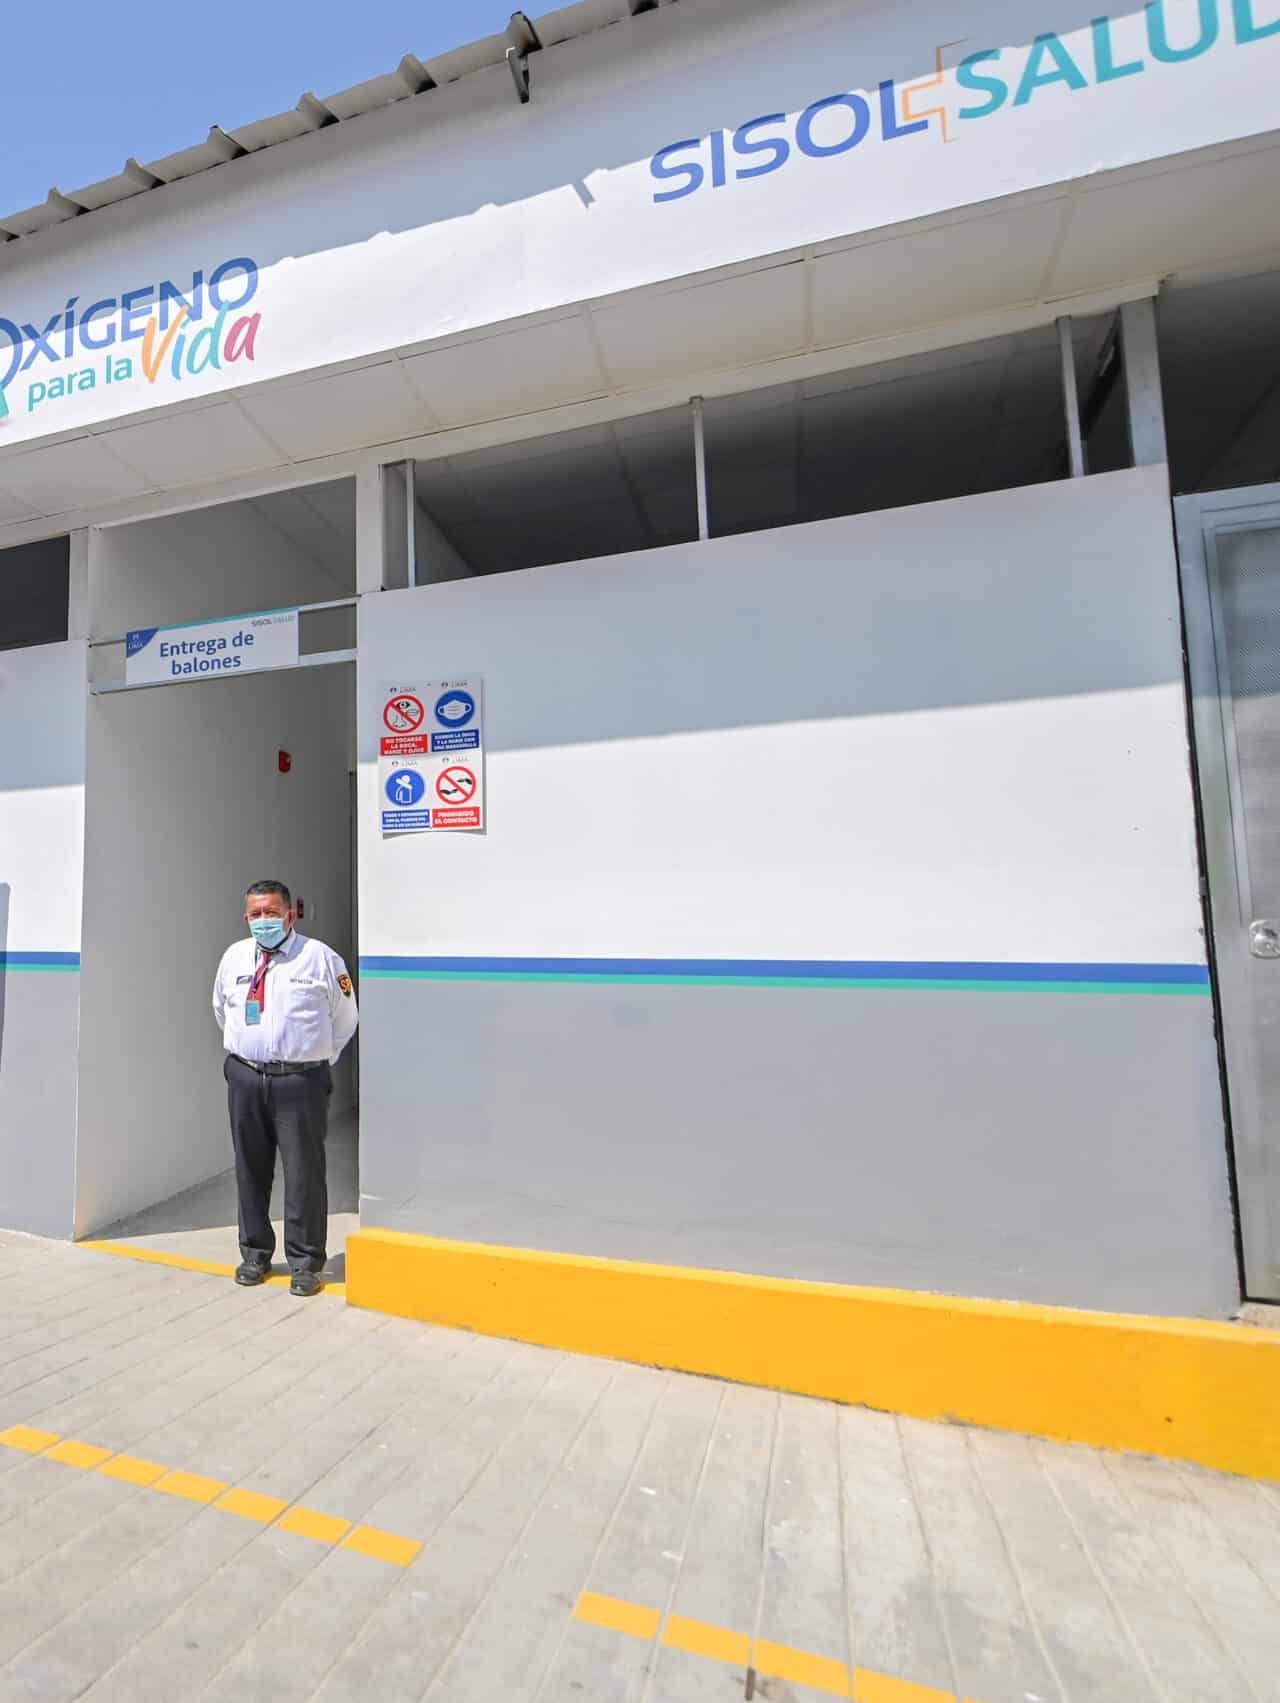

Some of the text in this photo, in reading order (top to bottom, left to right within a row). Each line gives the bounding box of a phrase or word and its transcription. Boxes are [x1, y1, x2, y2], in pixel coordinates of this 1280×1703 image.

[651, 79, 929, 204] SISOL
[28, 300, 261, 412] para la Vida
[160, 630, 254, 658] Entrega de
[172, 655, 242, 675] balones
